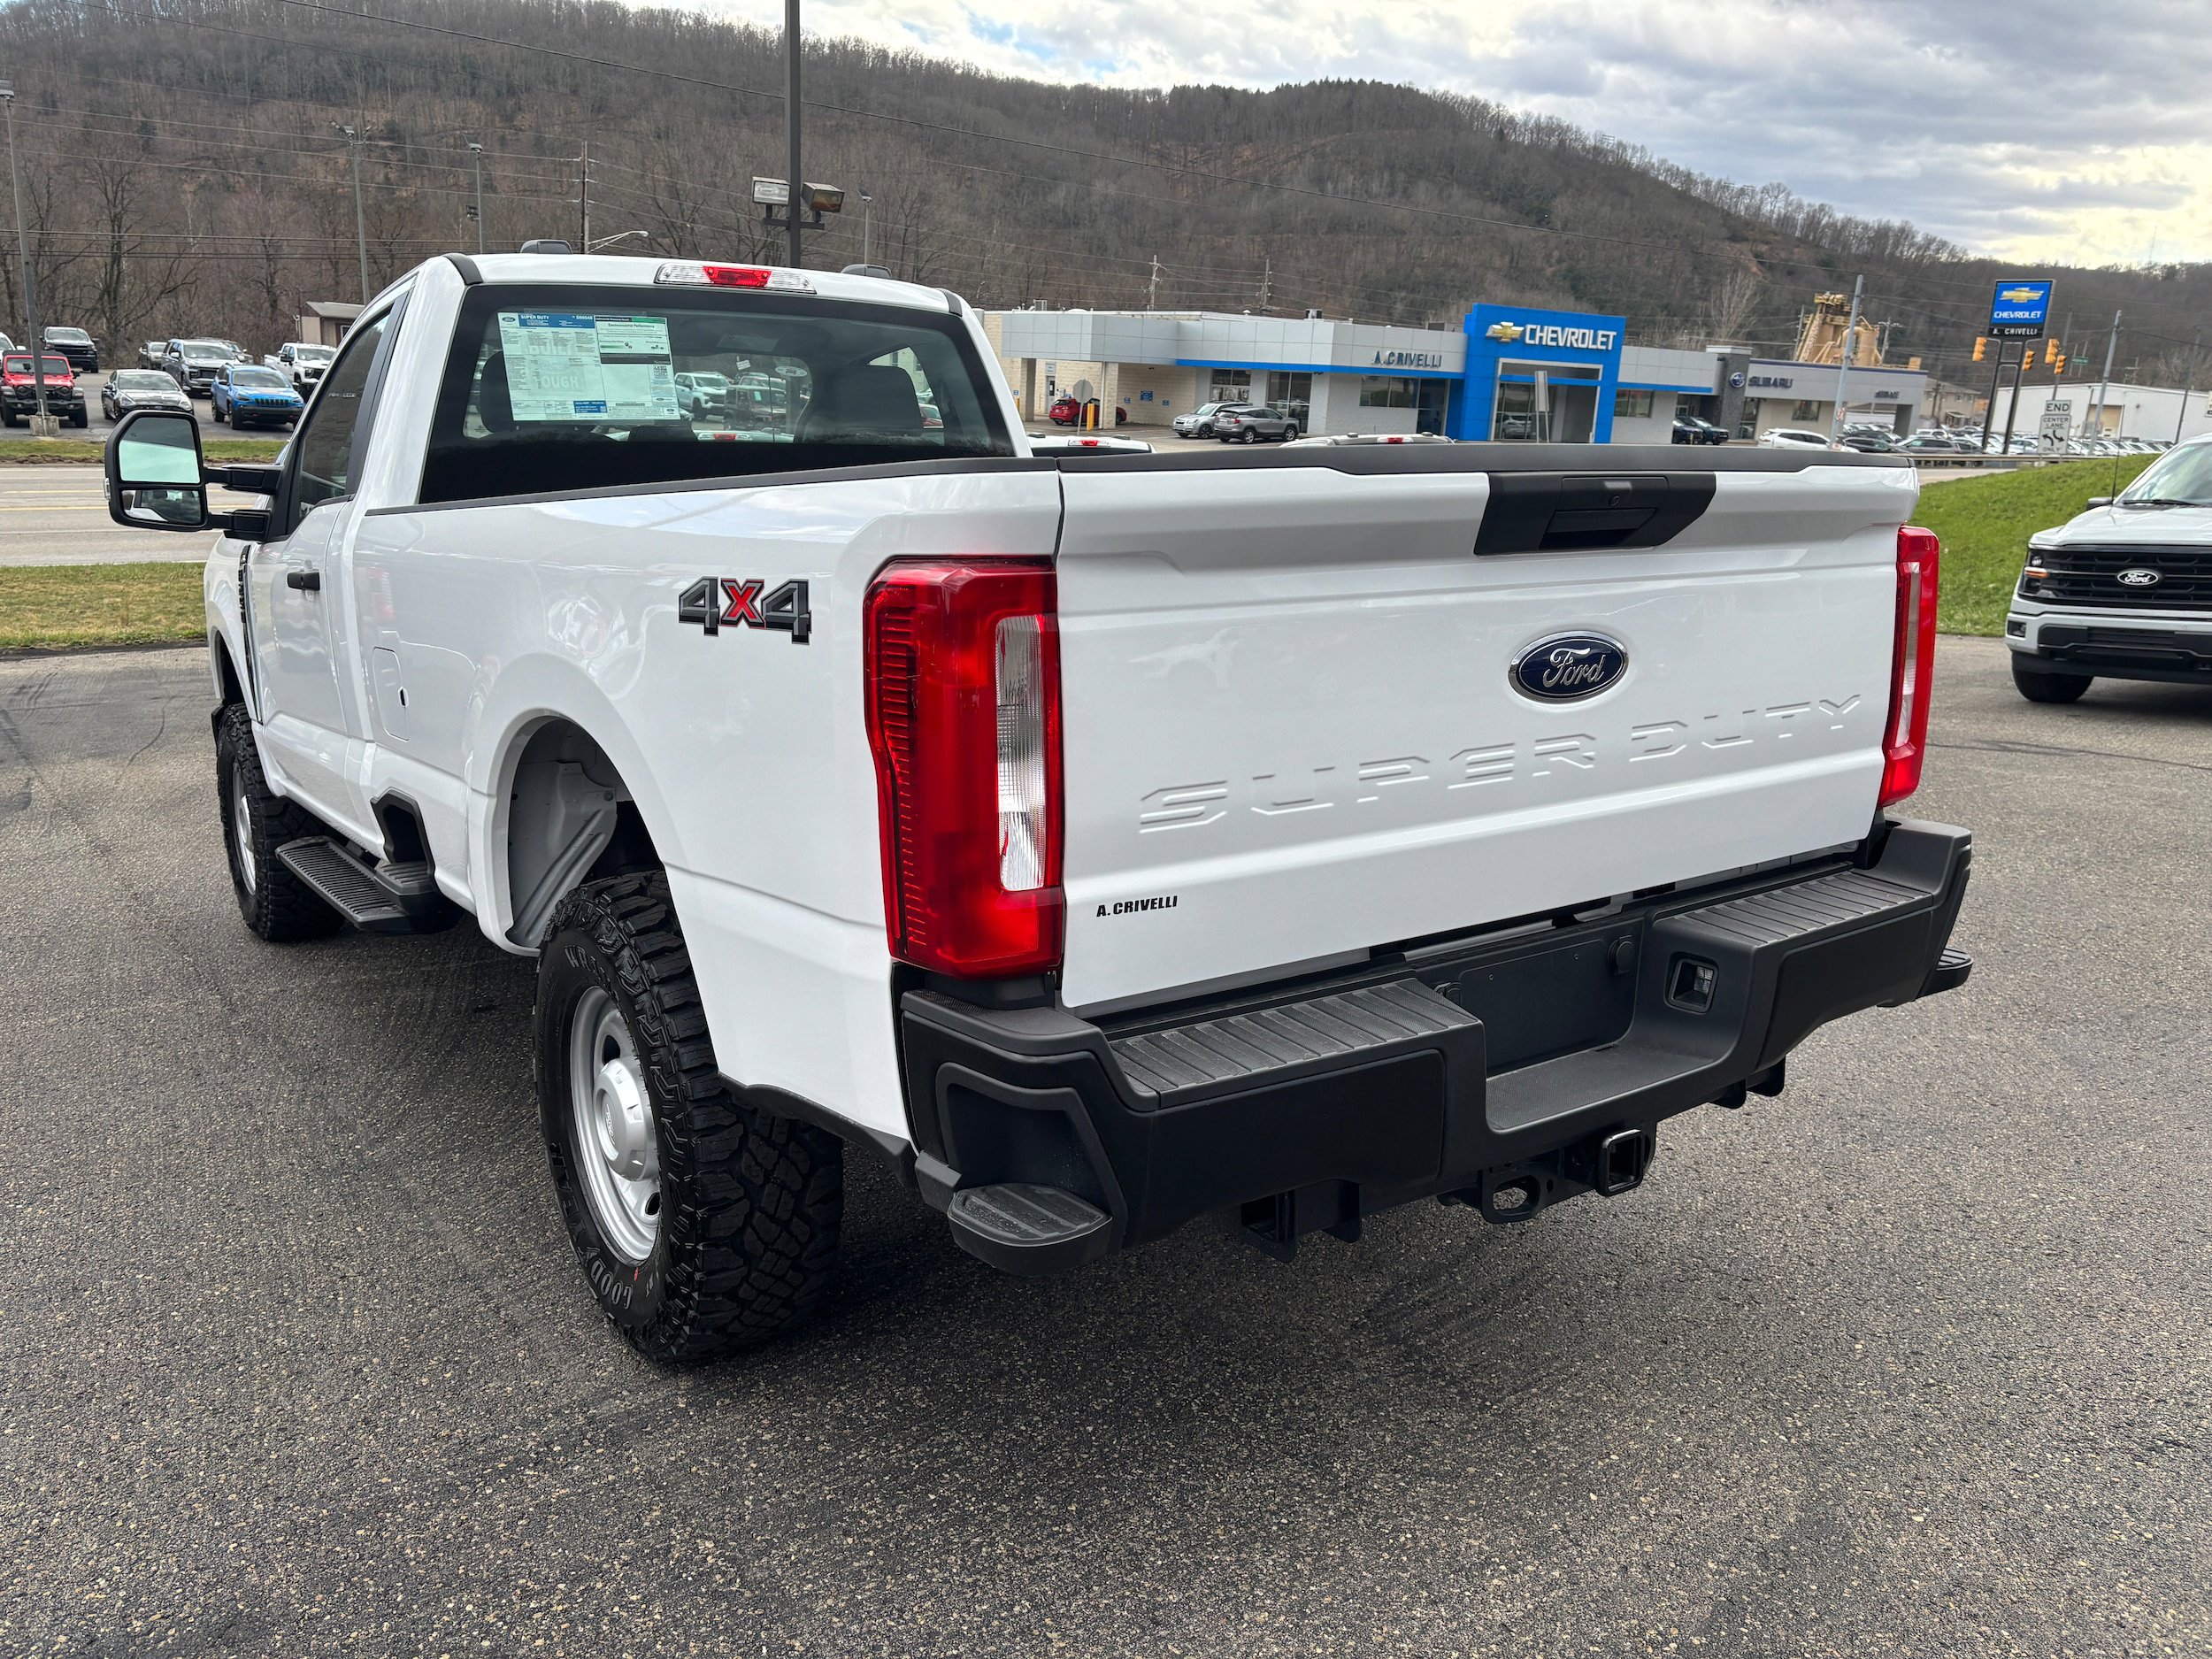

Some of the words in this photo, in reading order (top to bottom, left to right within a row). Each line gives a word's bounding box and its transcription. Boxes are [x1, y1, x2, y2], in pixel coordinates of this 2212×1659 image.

[1525, 324, 1617, 350] CHEVROLET
[1387, 351, 1442, 367] CRIVELLI
[2124, 572, 2150, 583] Ford
[1543, 648, 1606, 687] Ford
[1139, 733, 1595, 833] SUPER
[1630, 695, 1860, 762] DUTY
[1096, 904, 1110, 917] A.
[1113, 895, 1178, 915] CRIVELLI
